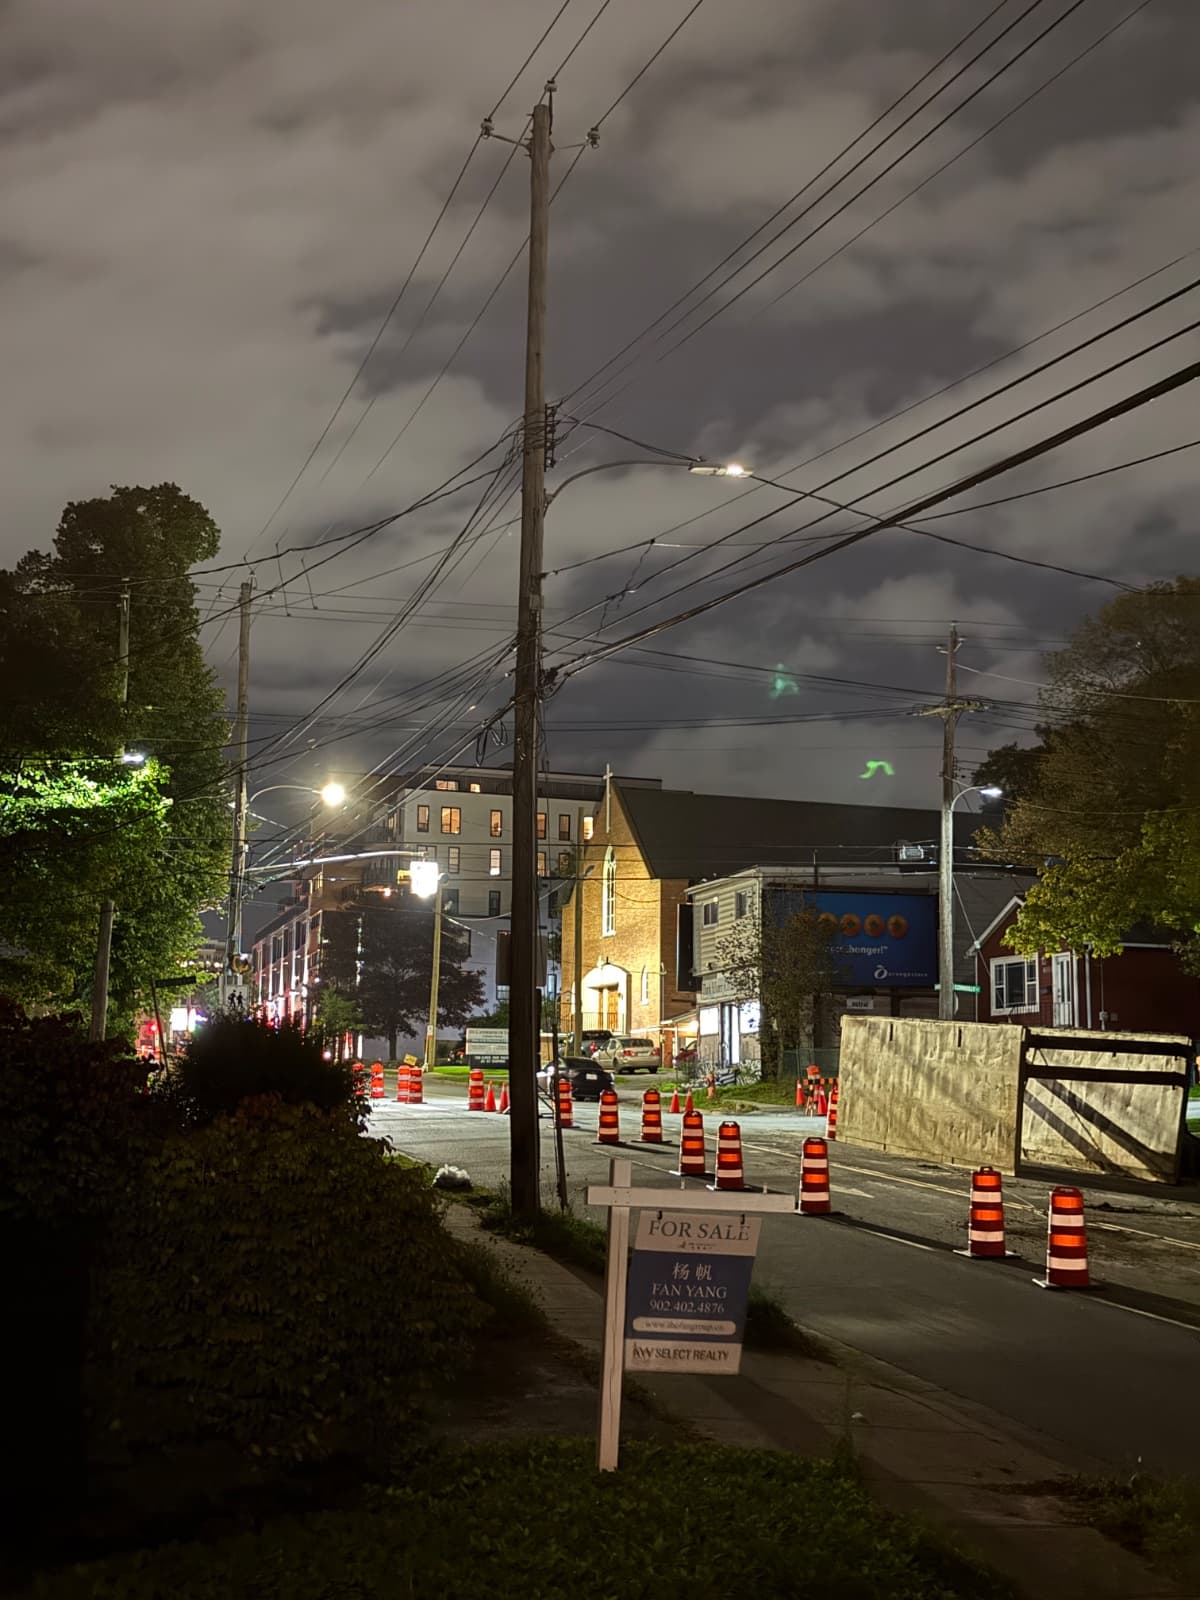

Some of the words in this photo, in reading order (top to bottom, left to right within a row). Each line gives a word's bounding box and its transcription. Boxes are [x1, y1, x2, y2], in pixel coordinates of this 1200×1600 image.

[648, 1220, 691, 1238] FOR
[697, 1223, 750, 1240] SALE
[652, 1283, 681, 1296] FAN
[686, 1284, 727, 1299] YANG
[650, 1300, 724, 1313] 902.402.4876
[654, 1347, 691, 1361] SELECT
[693, 1348, 728, 1361] REALTY
